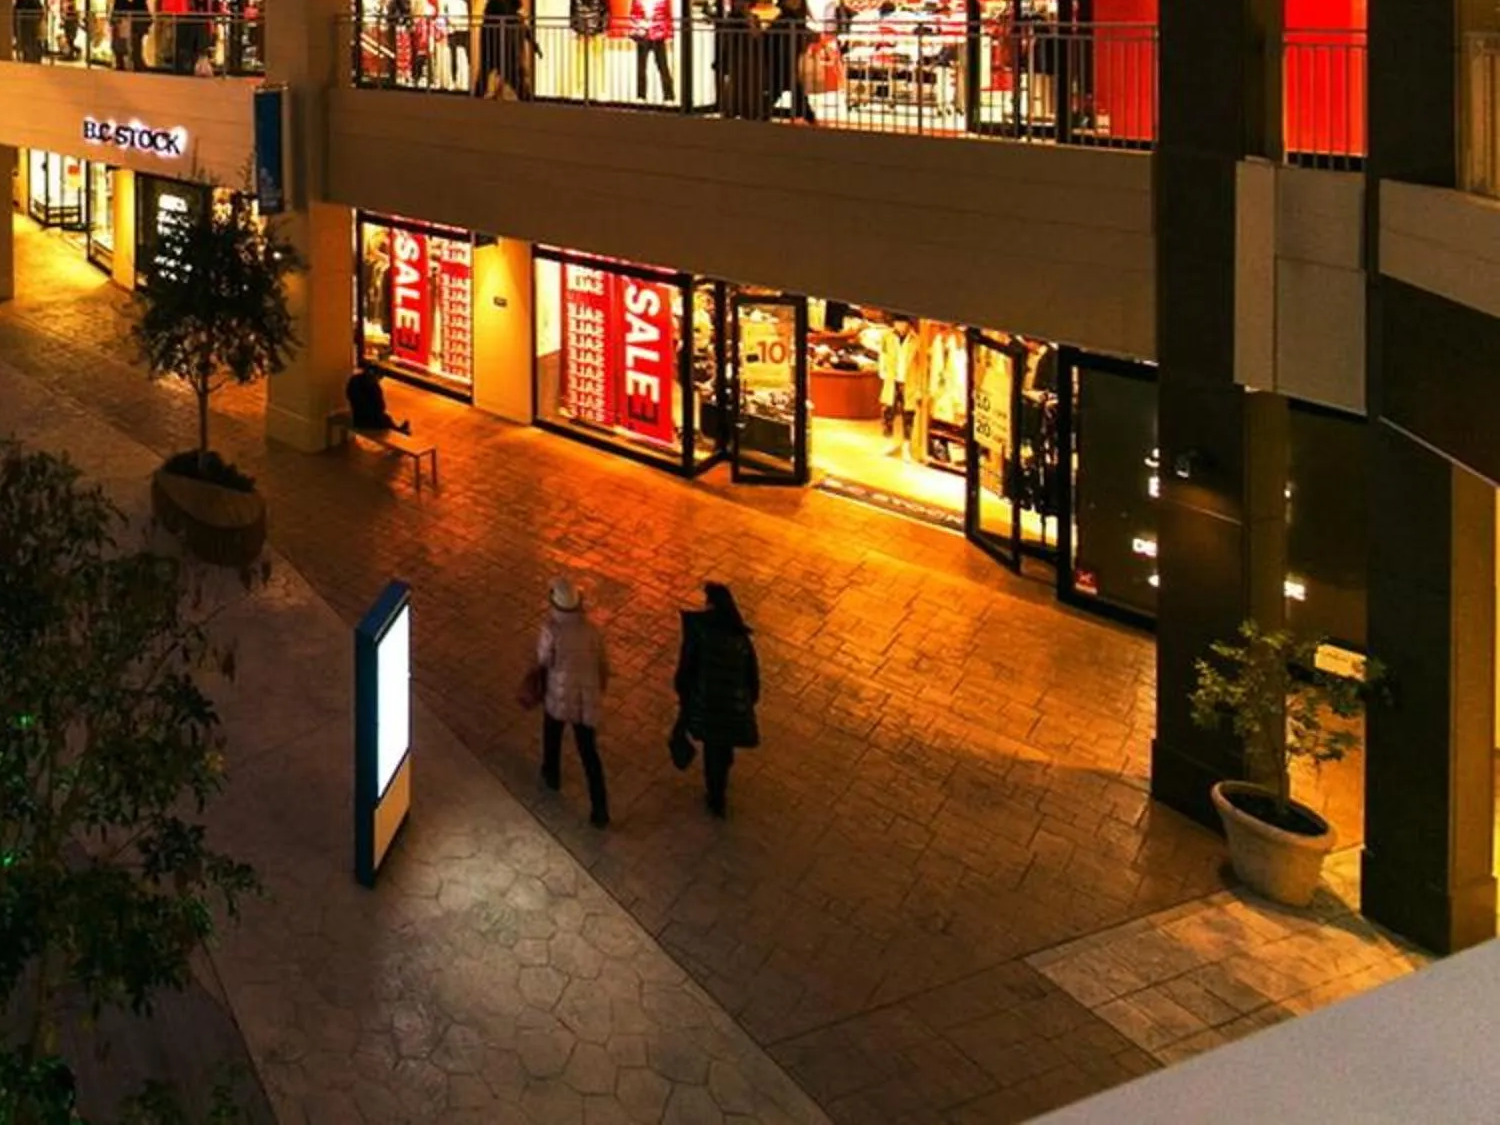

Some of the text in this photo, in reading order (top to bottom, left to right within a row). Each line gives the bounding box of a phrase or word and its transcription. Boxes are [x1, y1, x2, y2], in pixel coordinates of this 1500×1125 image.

[115, 125, 181, 155] STOCK
[394, 231, 421, 335] SALE
[624, 283, 661, 403] SALE
